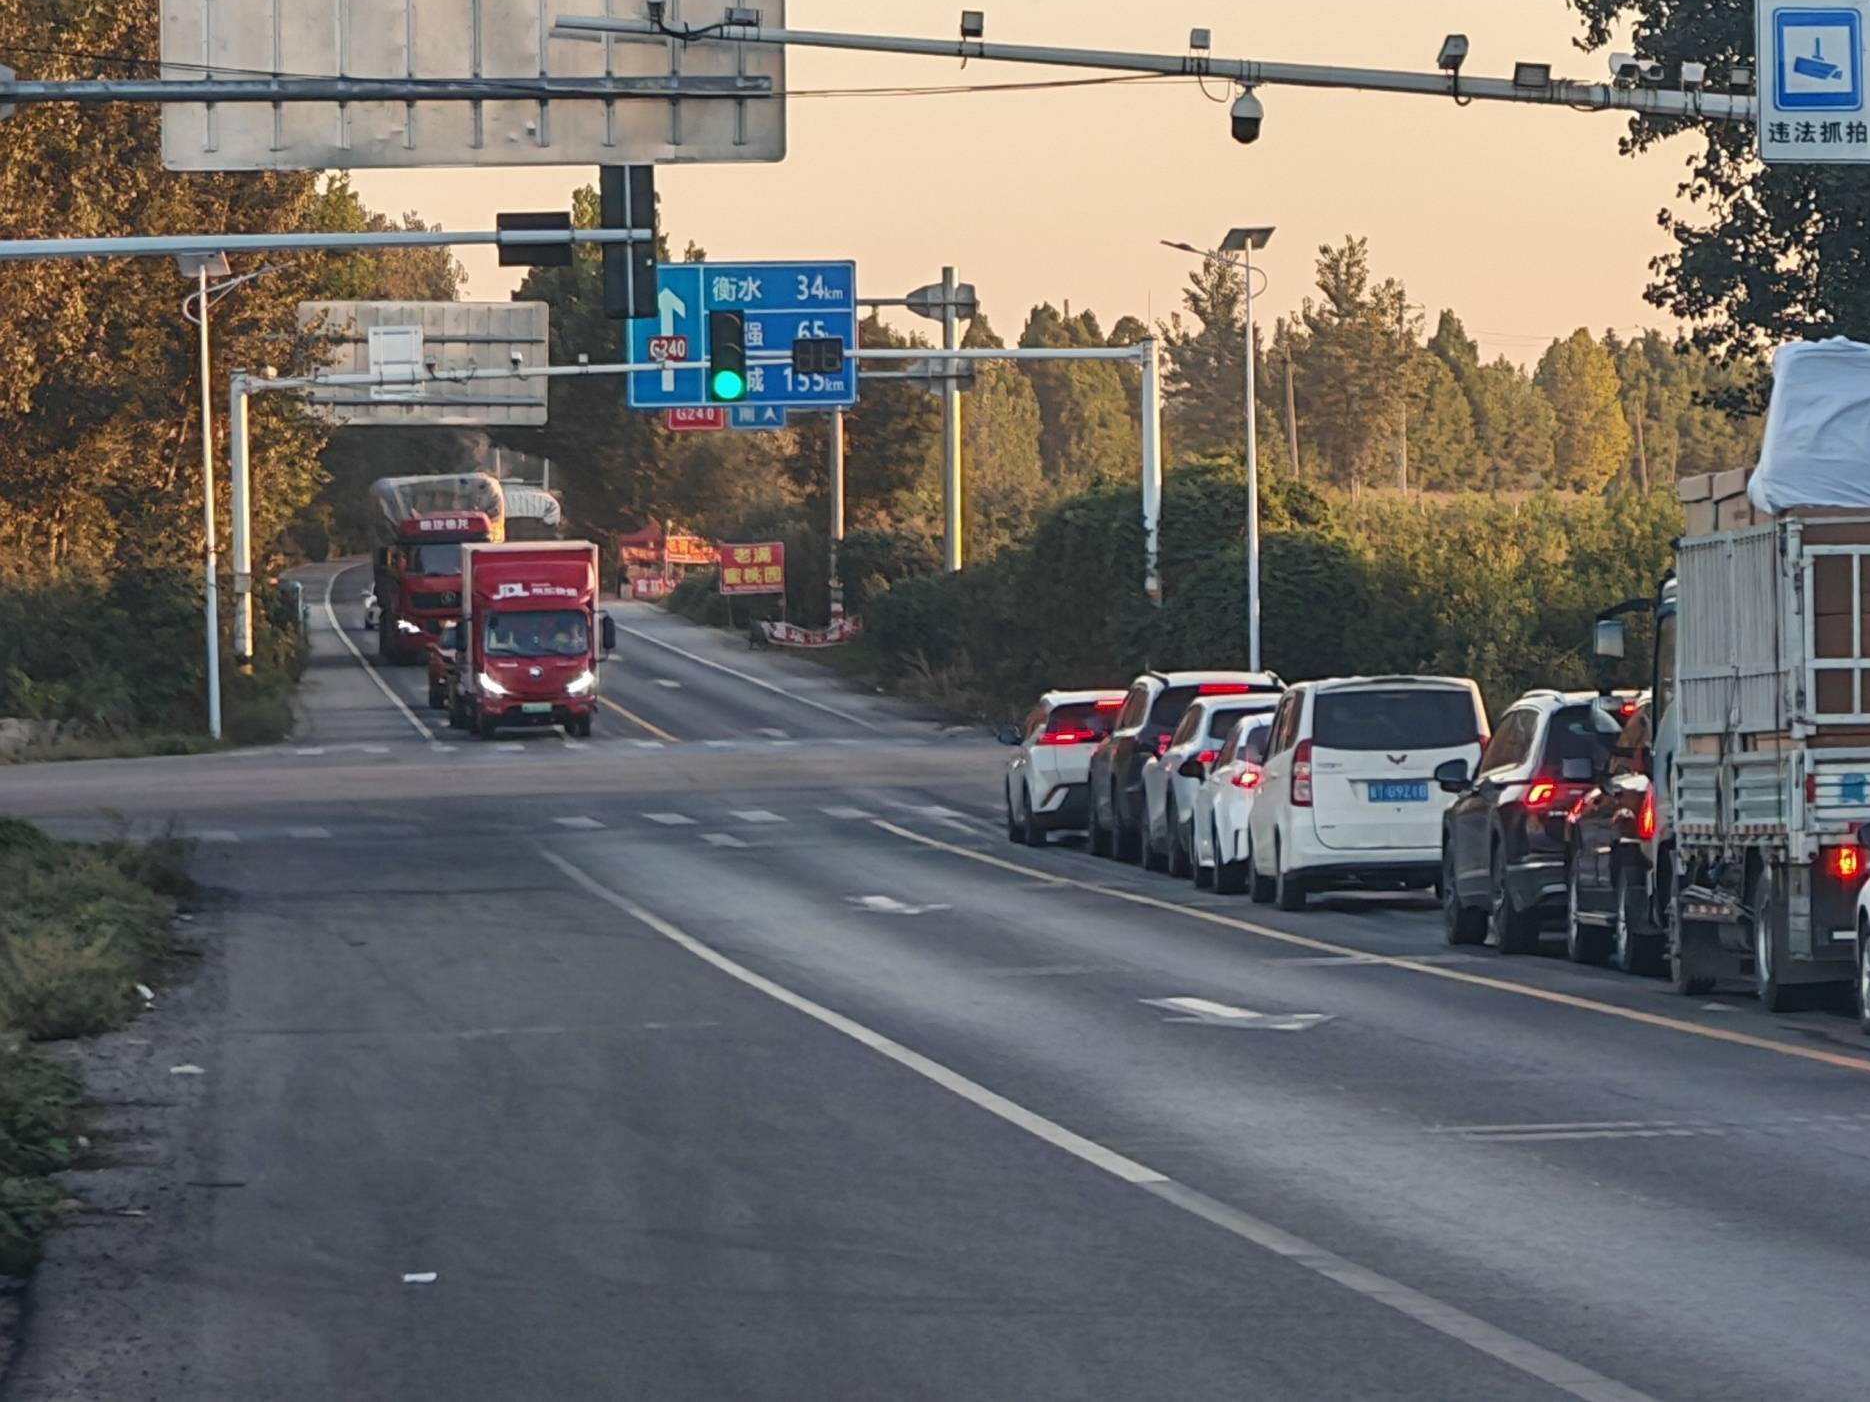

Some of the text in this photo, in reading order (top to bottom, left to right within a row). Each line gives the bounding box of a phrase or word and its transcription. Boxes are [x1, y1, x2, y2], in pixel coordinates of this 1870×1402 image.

[1768, 120, 1868, 144] 违法抓拍
[712, 276, 762, 302] 衡水
[650, 339, 686, 358] G240
[492, 582, 530, 600] JDL
